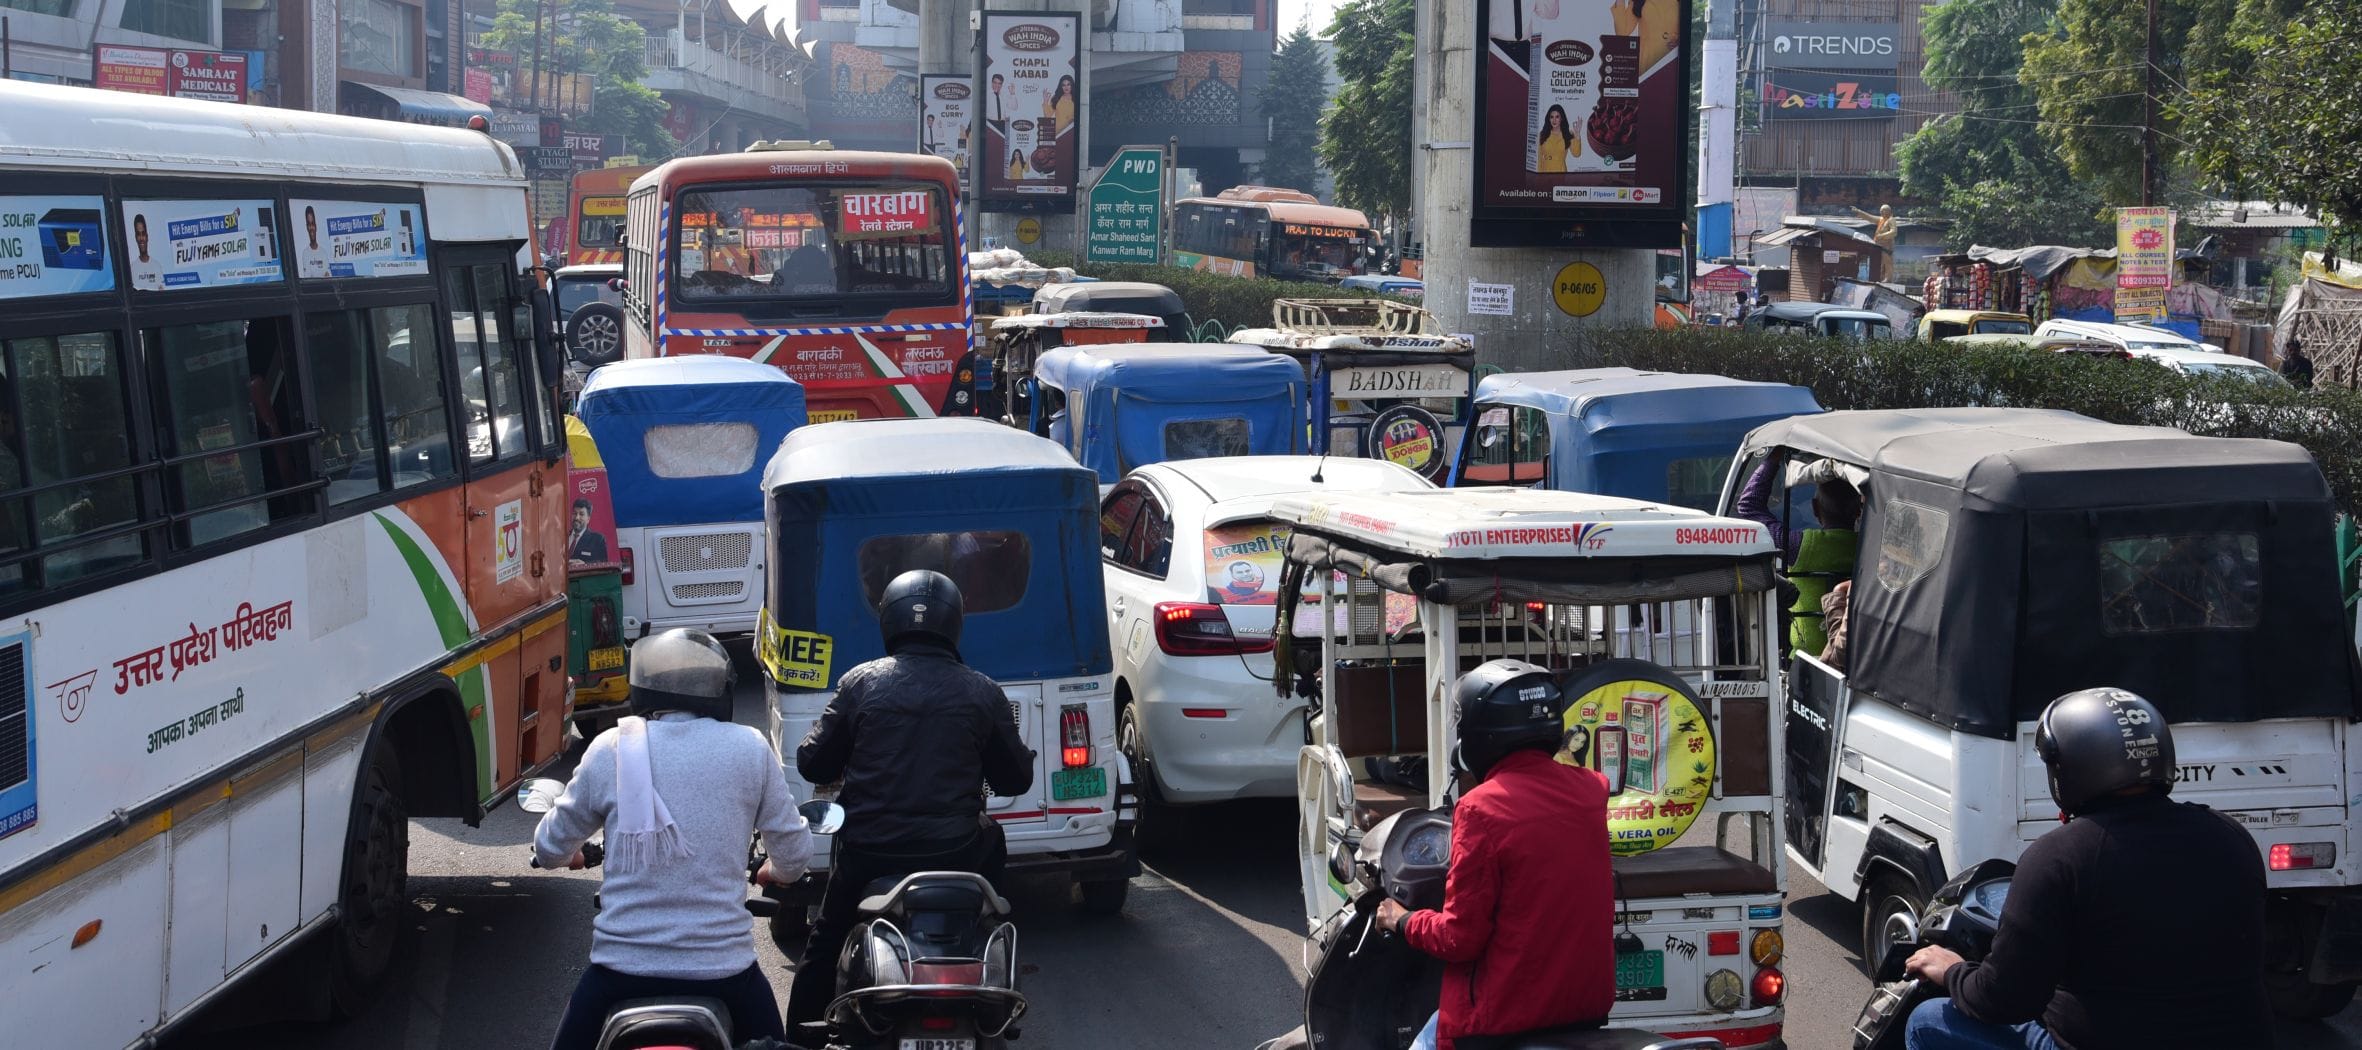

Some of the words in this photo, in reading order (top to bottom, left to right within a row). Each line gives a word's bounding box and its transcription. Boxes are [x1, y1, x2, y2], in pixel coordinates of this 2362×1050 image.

[1009, 32, 1028, 42] WAH
[1030, 32, 1052, 44] INDIA
[1792, 35, 1893, 55] TRENDS
[1013, 58, 1049, 67] CHAPLI
[182, 67, 237, 79] SAMRAAT
[1014, 70, 1048, 78] KABAB
[1552, 71, 1585, 79] CHICKEN
[180, 80, 236, 92] MEDICALS
[1551, 79, 1586, 87] LOLLIPOP
[1763, 82, 1901, 110] MastiZone
[541, 148, 568, 156] TYAGI
[538, 157, 571, 165] STUDIO
[1123, 159, 1156, 174] PWD
[769, 163, 822, 175] आलमबाग
[1499, 189, 1535, 198] Available
[844, 191, 926, 217] चारबाग
[1095, 203, 1111, 213] अमर
[1116, 201, 1134, 213] शहीद
[1139, 204, 1153, 214] सन्त
[3, 213, 36, 228] SOLAR
[171, 224, 181, 236] Hit
[181, 223, 199, 236] Energy
[200, 219, 212, 230] Bills
[212, 218, 220, 228] for
[225, 213, 238, 228] SIX
[373, 215, 383, 227] SIX
[1119, 219, 1131, 229] राम
[1136, 217, 1149, 230] मार्ग
[1091, 232, 1109, 240] Amar
[1110, 232, 1139, 242] Shaheed
[1140, 233, 1155, 242] Sant
[1311, 227, 1321, 236] TO
[1325, 228, 1356, 238] LUCKN
[0, 238, 23, 258] NG
[222, 238, 247, 254] SOLAR
[371, 236, 392, 252] SOLAR
[1092, 245, 1118, 255] Kanwar
[1119, 246, 1135, 256] Ram
[1136, 247, 1153, 258] Marg
[17, 264, 41, 279] PCU)
[1561, 283, 1597, 294] P-06/05
[1364, 337, 1441, 347] BDSHAH
[797, 346, 844, 363] बाराबंकी
[905, 346, 945, 360] लखनऊ
[1350, 370, 1456, 392] BADSHAH
[1486, 526, 1572, 546] ENTERPRISES
[1675, 526, 1758, 544] 8948400777
[1588, 537, 1605, 550] YF
[113, 645, 165, 694] उत्तर
[169, 622, 217, 682] प्रदेश
[222, 600, 292, 651] परिवहन
[147, 719, 185, 753] आपका
[187, 705, 218, 736] अपना
[220, 687, 244, 721] साथी
[1793, 699, 1826, 731] ELECTRIC
[1664, 787, 1684, 795] E-427
[9, 813, 22, 828] 885
[23, 808, 35, 822] 885
[1617, 829, 1653, 840] VERA
[1656, 827, 1677, 837] OIL
